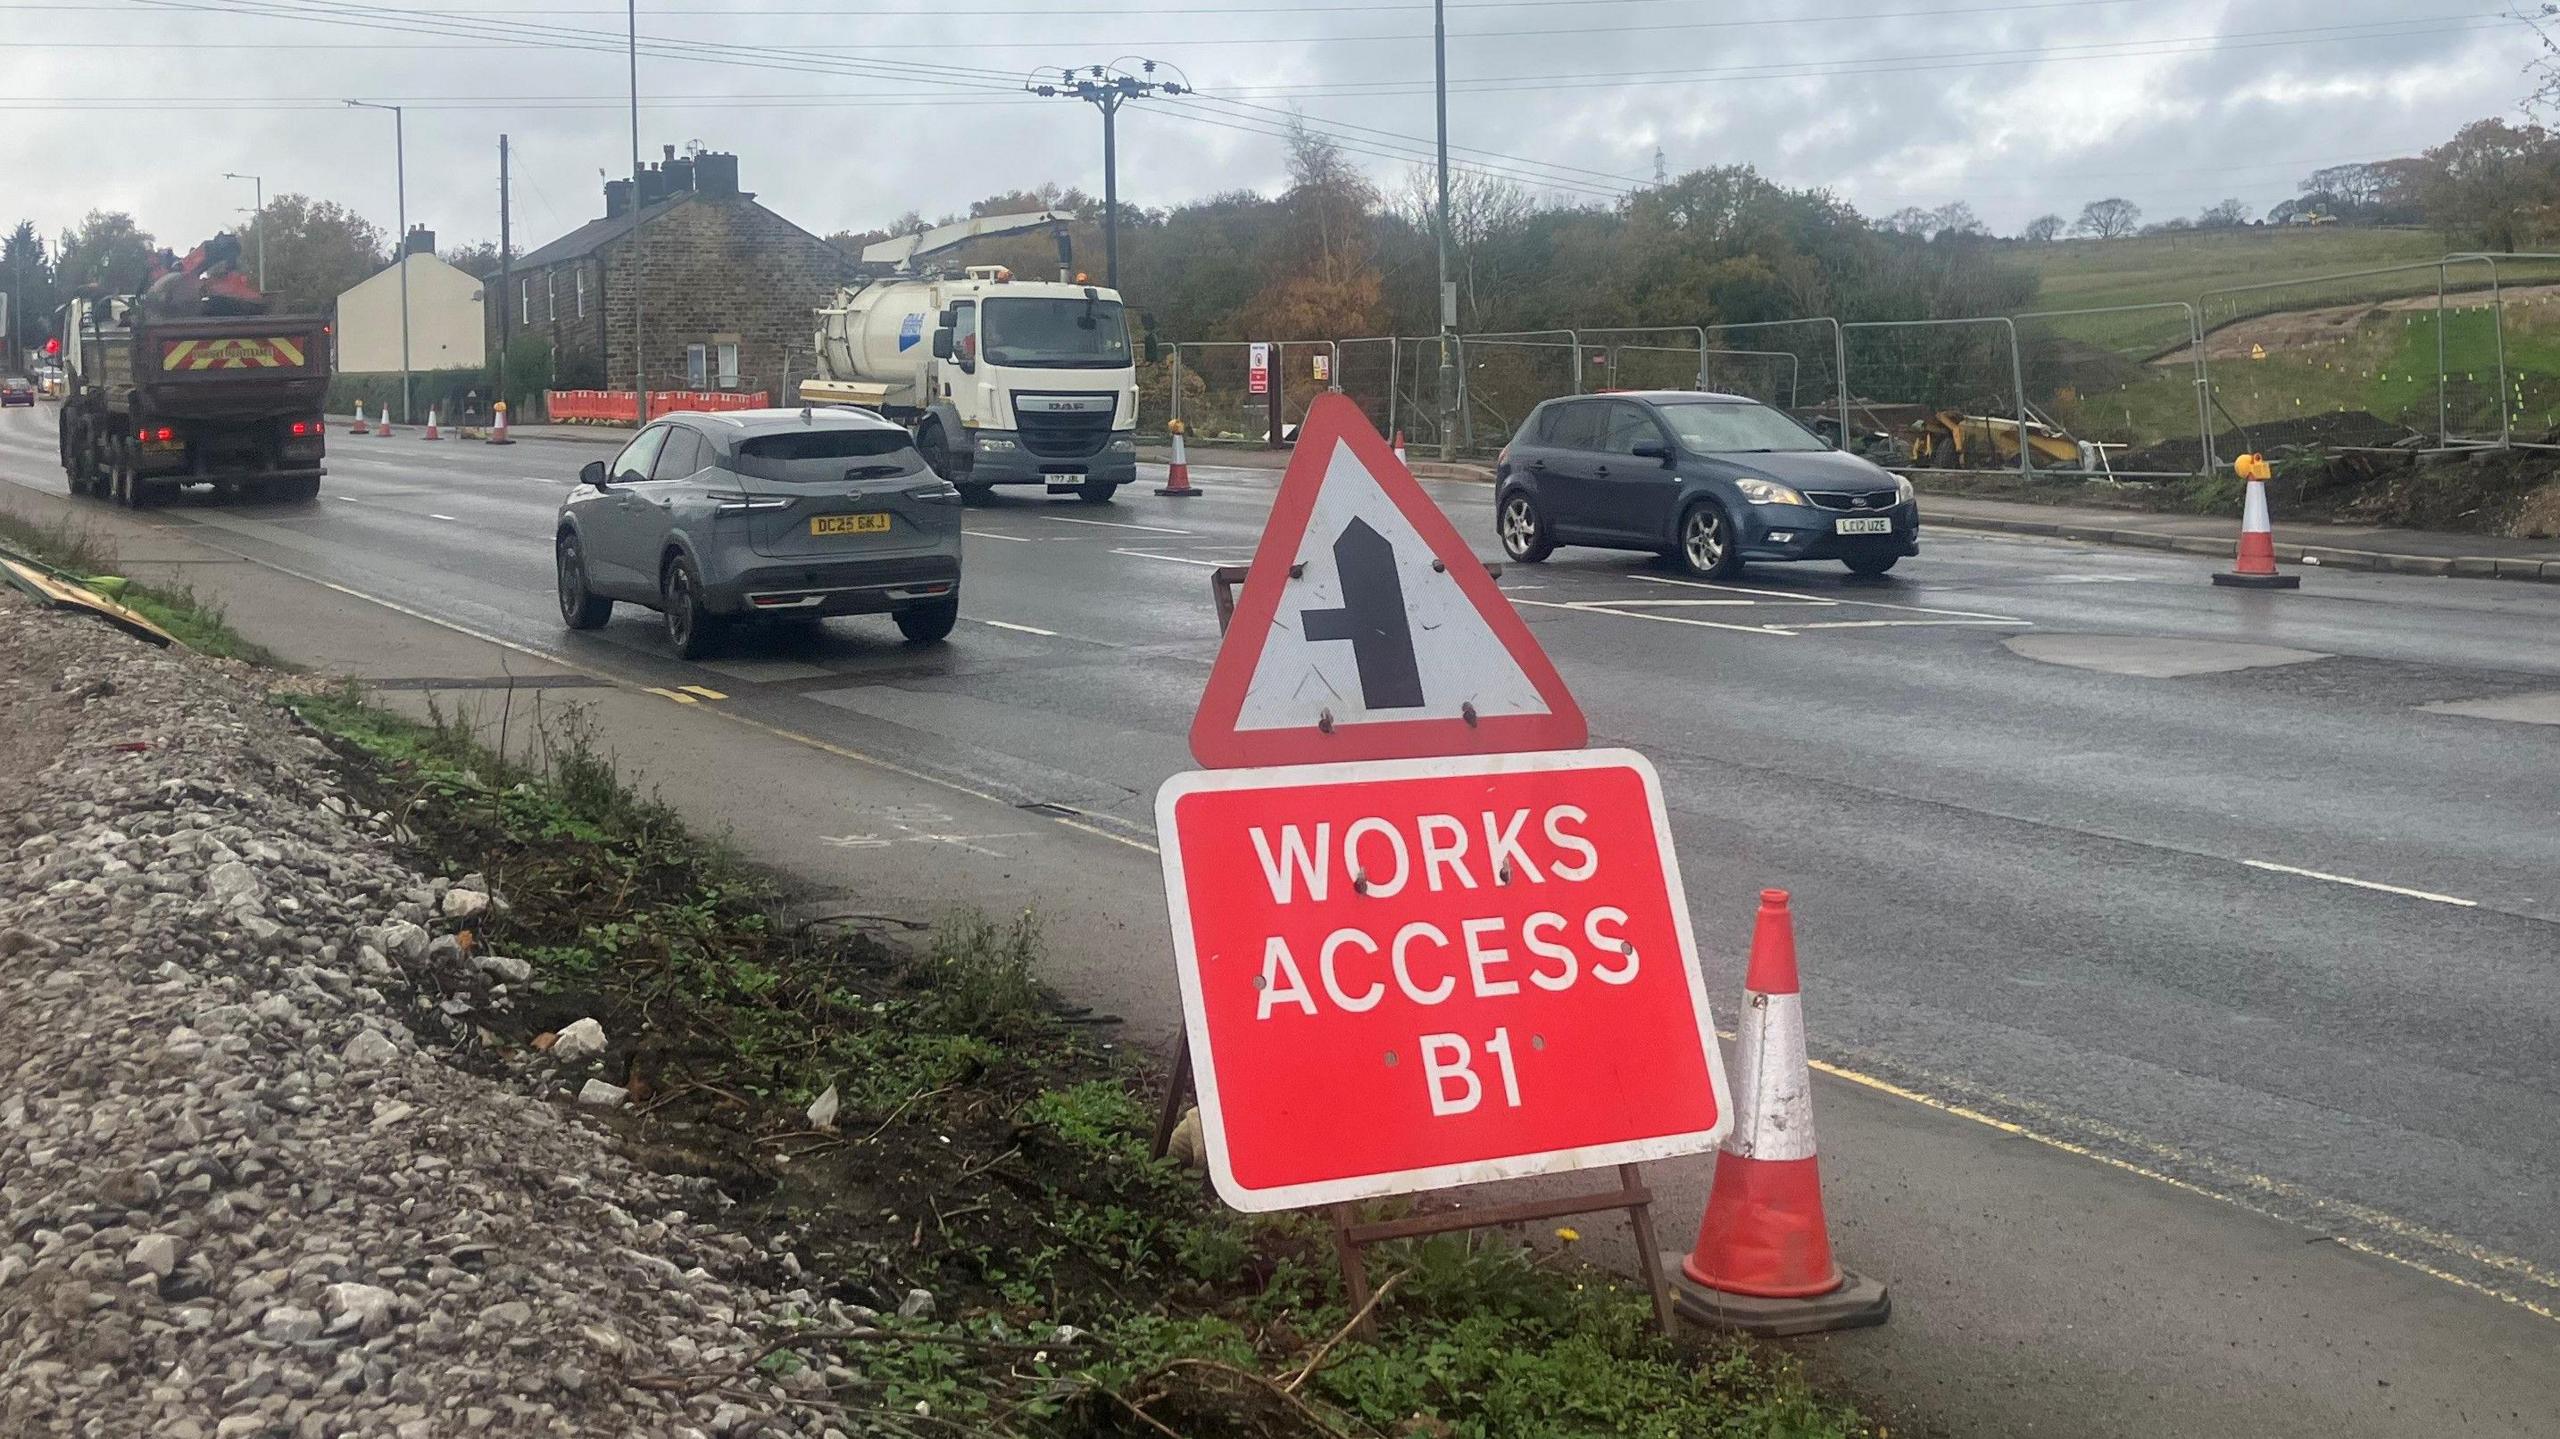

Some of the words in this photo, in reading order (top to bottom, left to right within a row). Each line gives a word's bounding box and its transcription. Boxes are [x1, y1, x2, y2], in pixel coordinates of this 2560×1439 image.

[1048, 402, 1084, 411] DAF
[818, 517, 855, 532] DC25
[1867, 520, 1887, 532] UZE
[1249, 804, 1598, 904] WORKS
[1256, 906, 1640, 1020] ACCESS
[1419, 1027, 1522, 1117] B1
